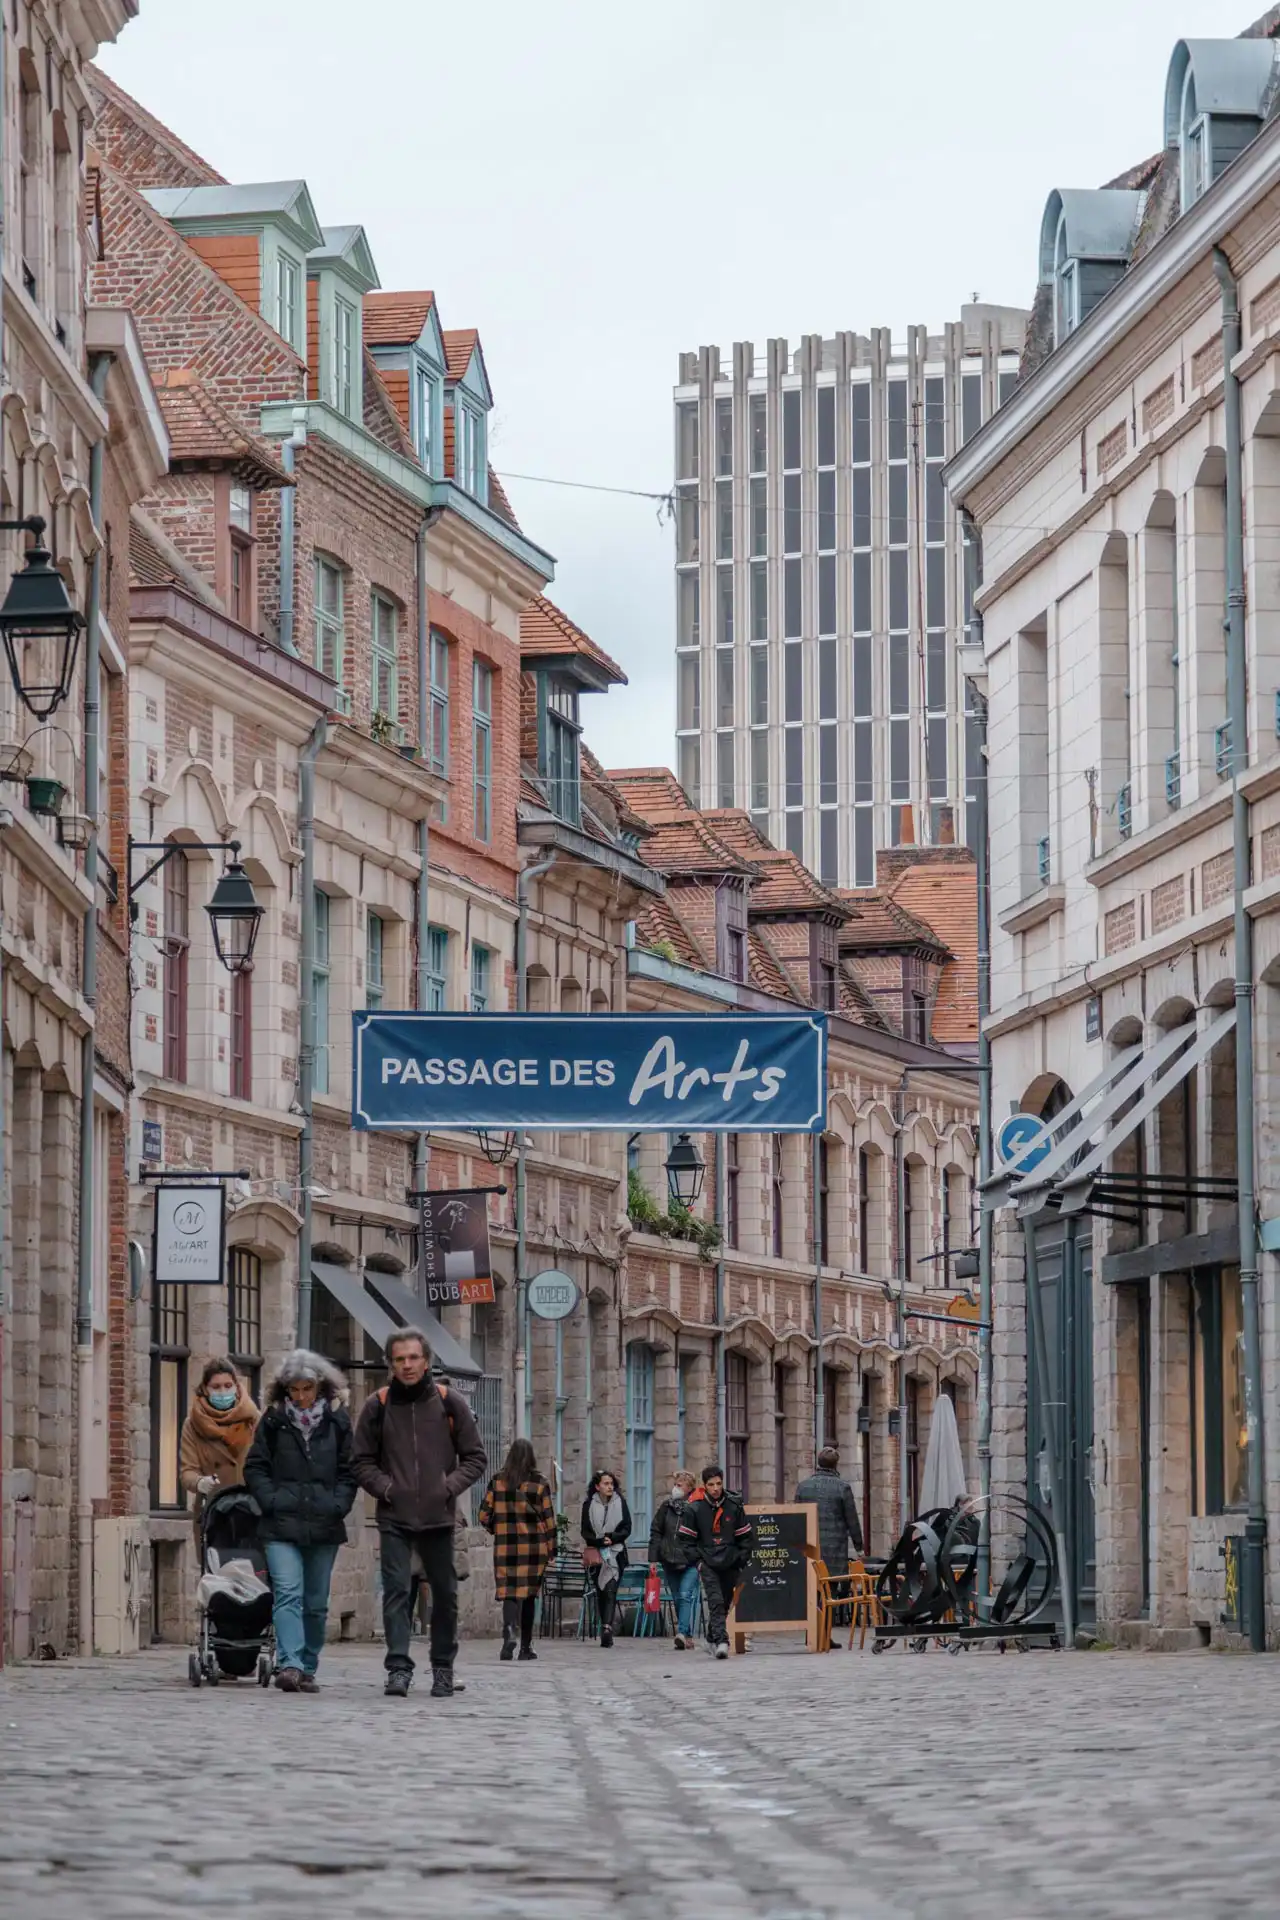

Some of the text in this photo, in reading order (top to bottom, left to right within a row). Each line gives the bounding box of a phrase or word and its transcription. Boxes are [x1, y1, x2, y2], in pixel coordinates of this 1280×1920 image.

[381, 1035, 787, 1106] PASSAGE DES Arts
[429, 1284, 488, 1301] DUBART
